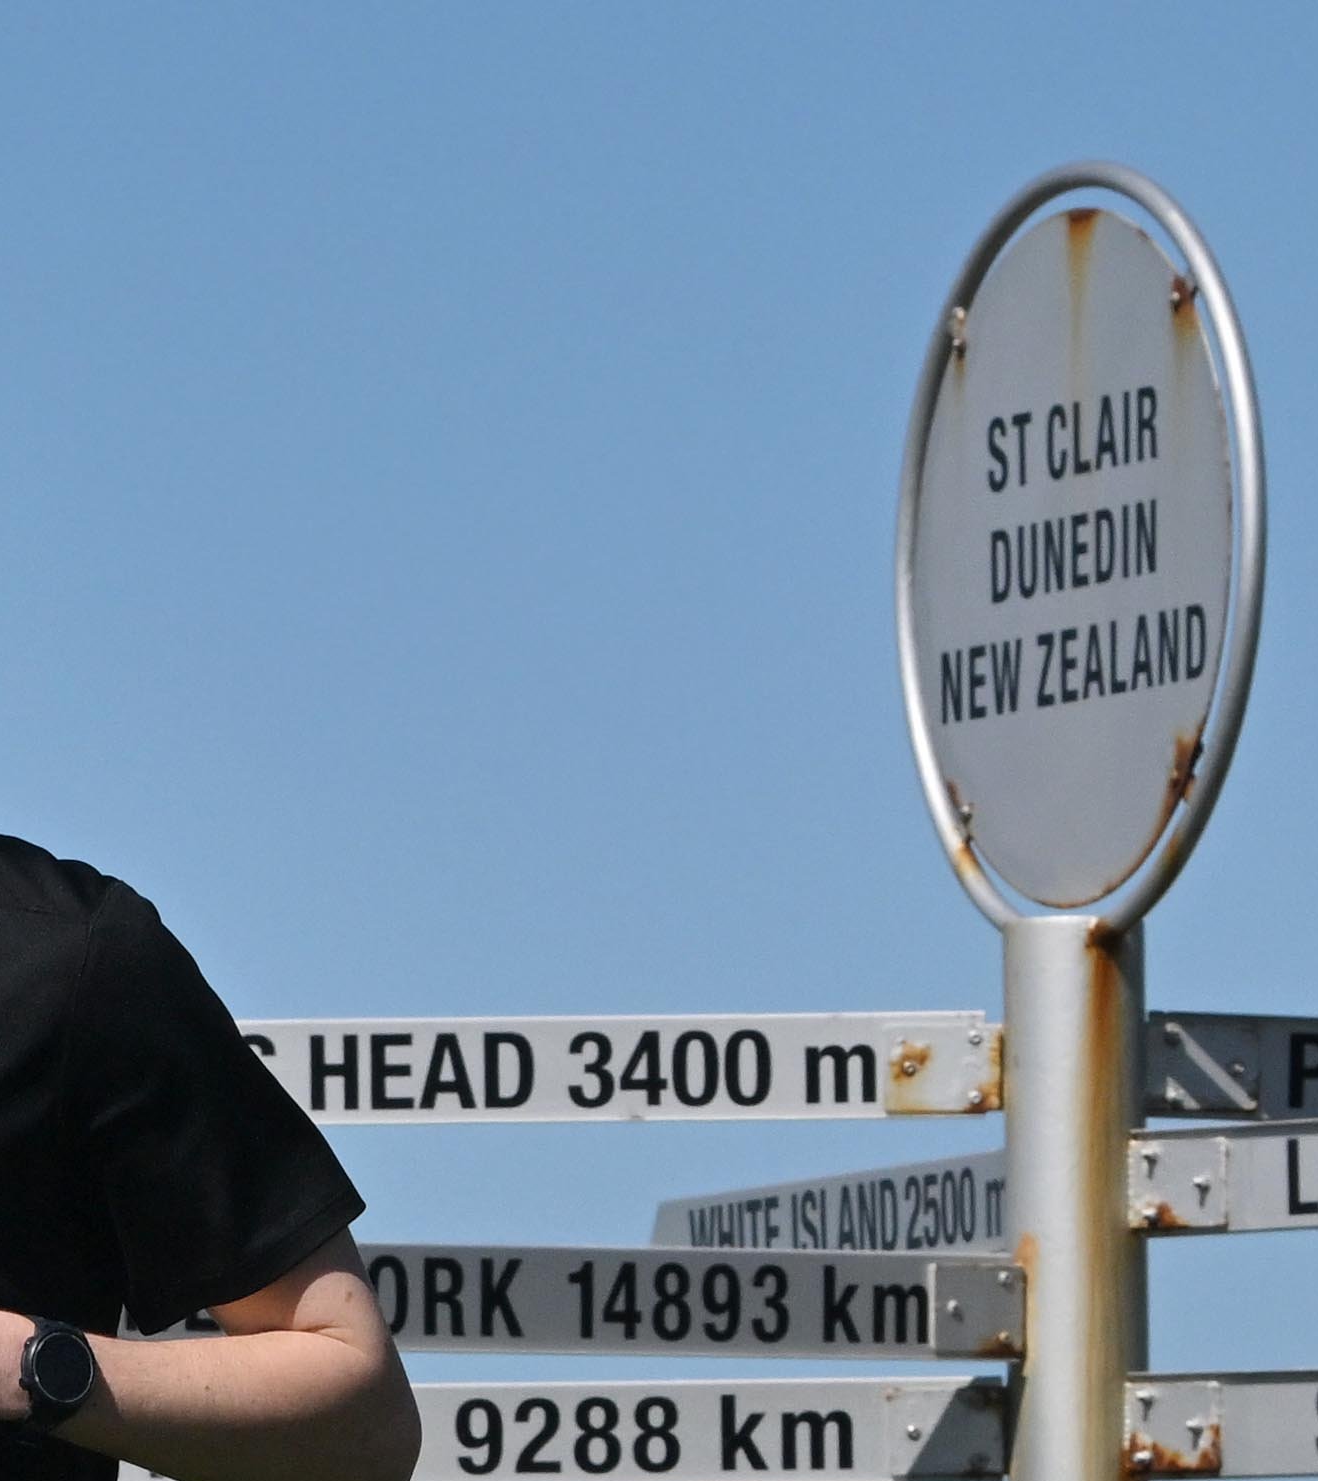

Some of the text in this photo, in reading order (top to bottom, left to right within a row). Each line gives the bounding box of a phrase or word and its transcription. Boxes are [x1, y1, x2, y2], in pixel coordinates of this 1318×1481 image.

[987, 385, 1159, 493] ST CLAIR
[991, 498, 1159, 604] DUNEDIN
[940, 603, 1208, 725] NEW ZEALAND
[309, 1029, 877, 1111] HEAD 3400 m
[904, 1167, 975, 1248] 2500
[369, 1255, 929, 1345] ORK 14893 km
[455, 1394, 854, 1475] 9288 km
